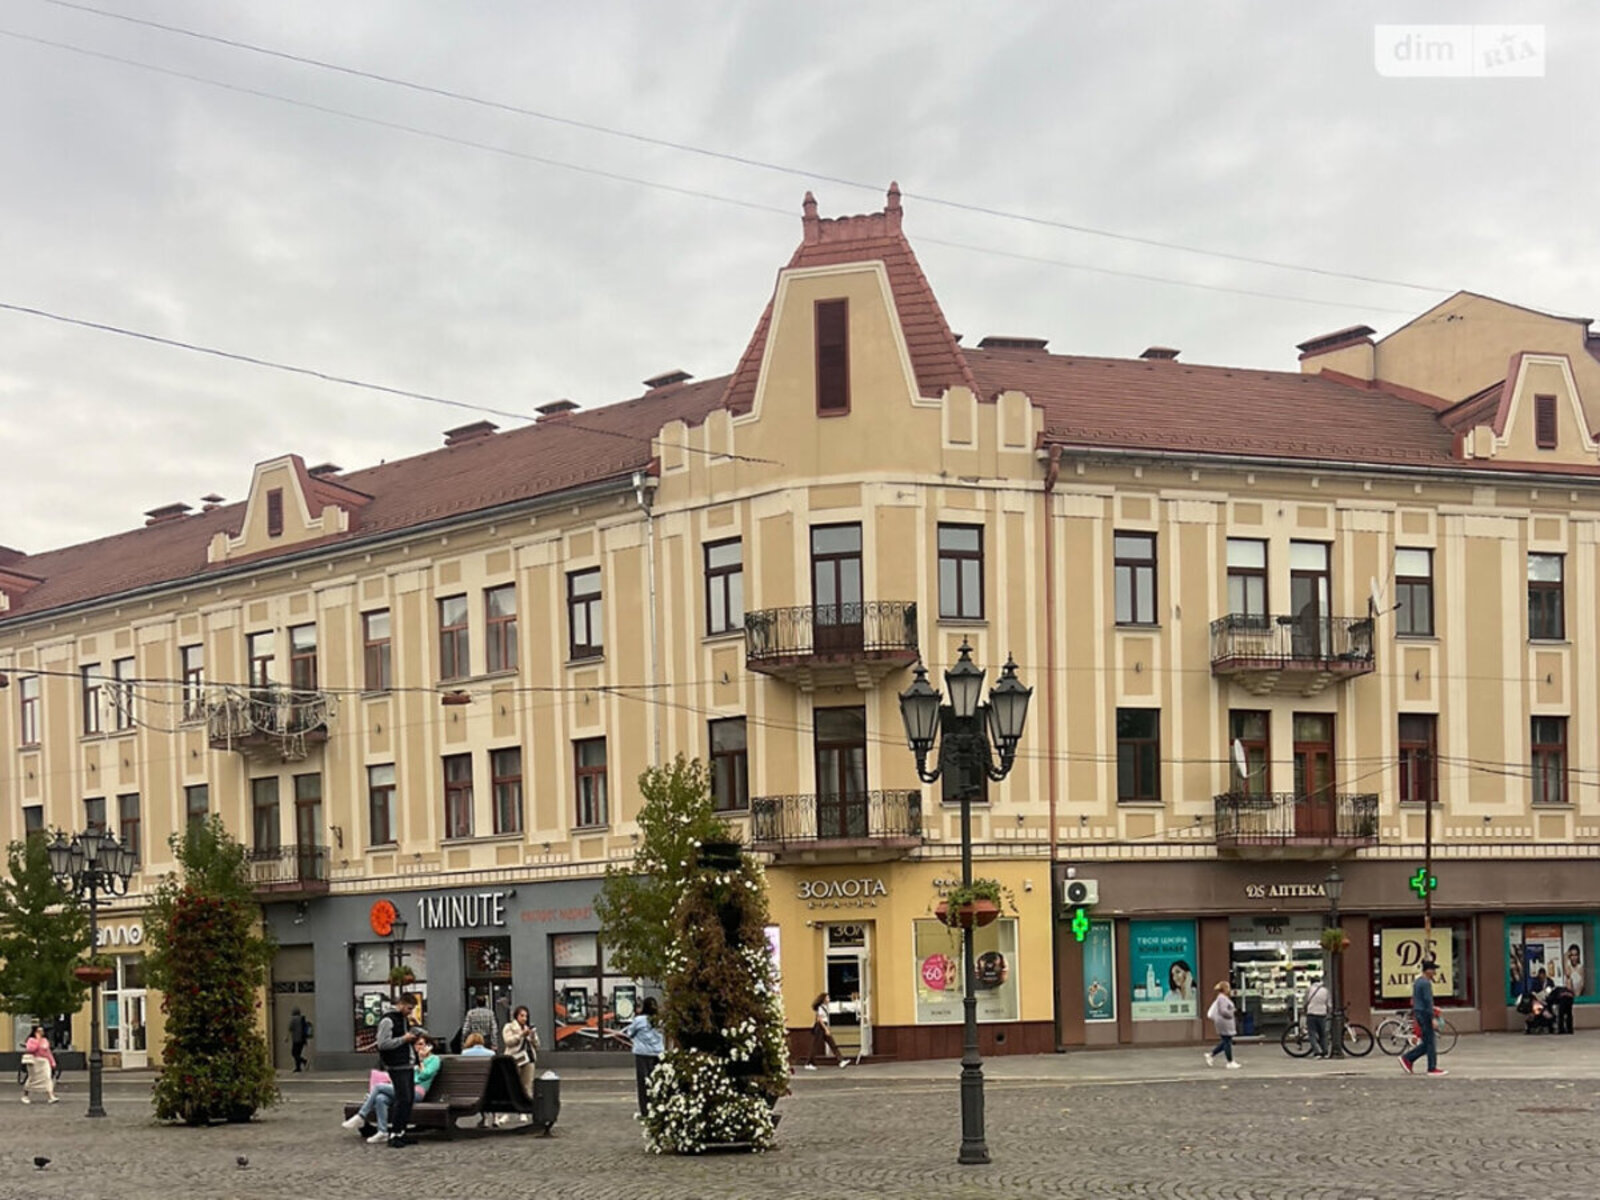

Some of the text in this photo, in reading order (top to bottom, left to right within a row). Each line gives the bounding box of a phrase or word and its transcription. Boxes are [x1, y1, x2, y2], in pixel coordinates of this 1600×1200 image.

[798, 879, 888, 899] ЗОЛОТА
[1269, 885, 1326, 896] АПТЕКА
[417, 893, 505, 929] 1MINUTE
